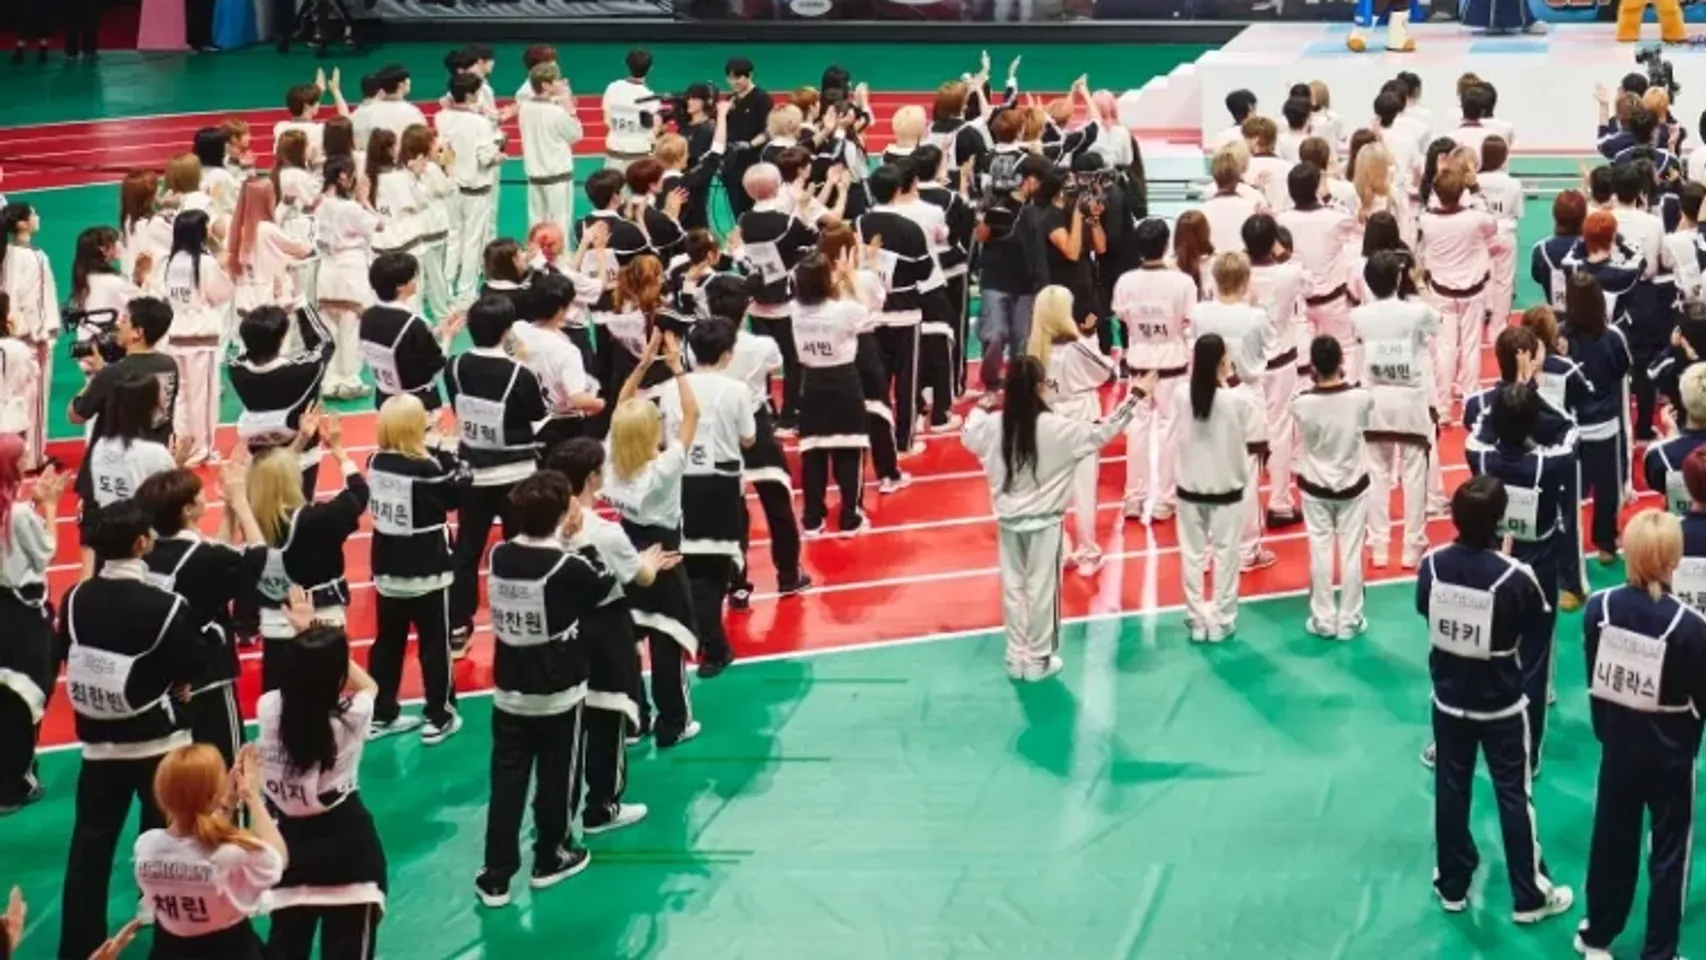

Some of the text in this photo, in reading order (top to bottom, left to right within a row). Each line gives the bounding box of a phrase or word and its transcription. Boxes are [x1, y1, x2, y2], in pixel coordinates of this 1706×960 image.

[1439, 618, 1481, 647] 타키
[1596, 662, 1656, 698] 니콜라스
[153, 894, 211, 923] 채린
